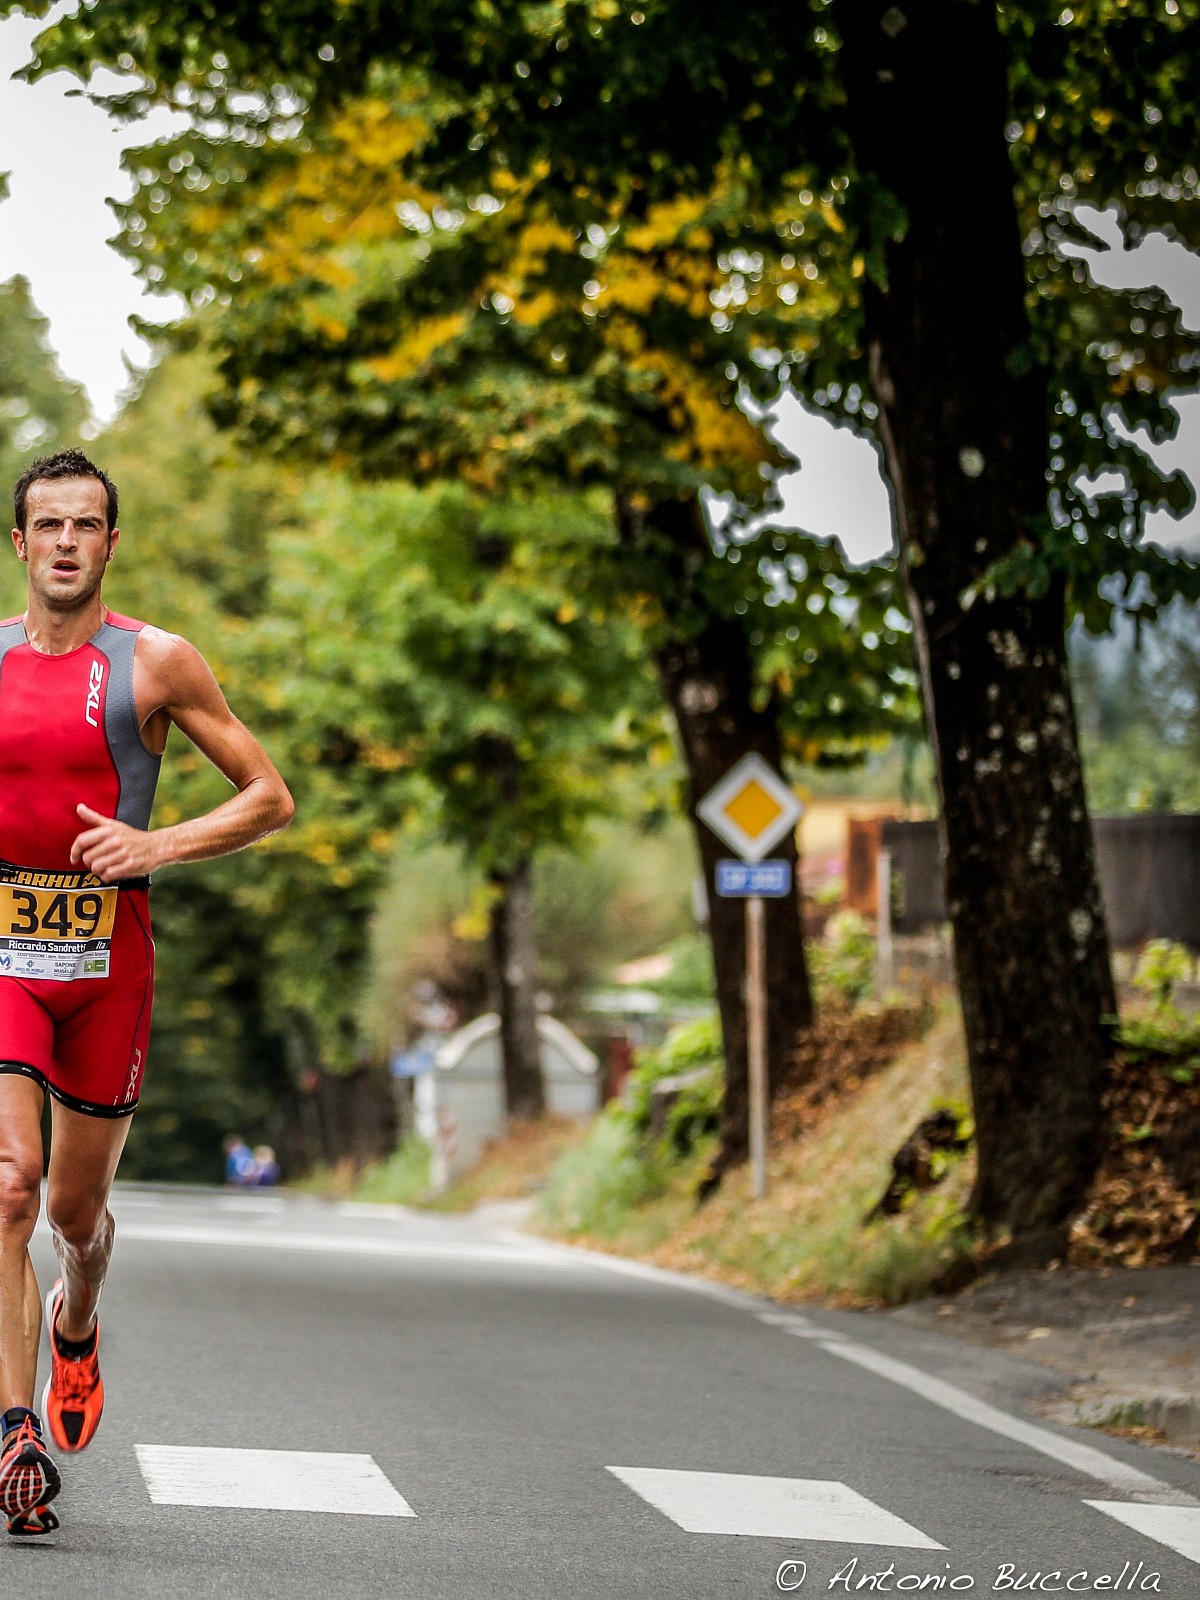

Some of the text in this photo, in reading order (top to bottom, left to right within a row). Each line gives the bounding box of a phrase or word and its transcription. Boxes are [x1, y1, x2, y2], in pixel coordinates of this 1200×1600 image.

[85, 659, 104, 728] 2XU
[10, 889, 103, 937] 349
[8, 940, 47, 951] Riccardo
[47, 942, 87, 953] Sandretti
